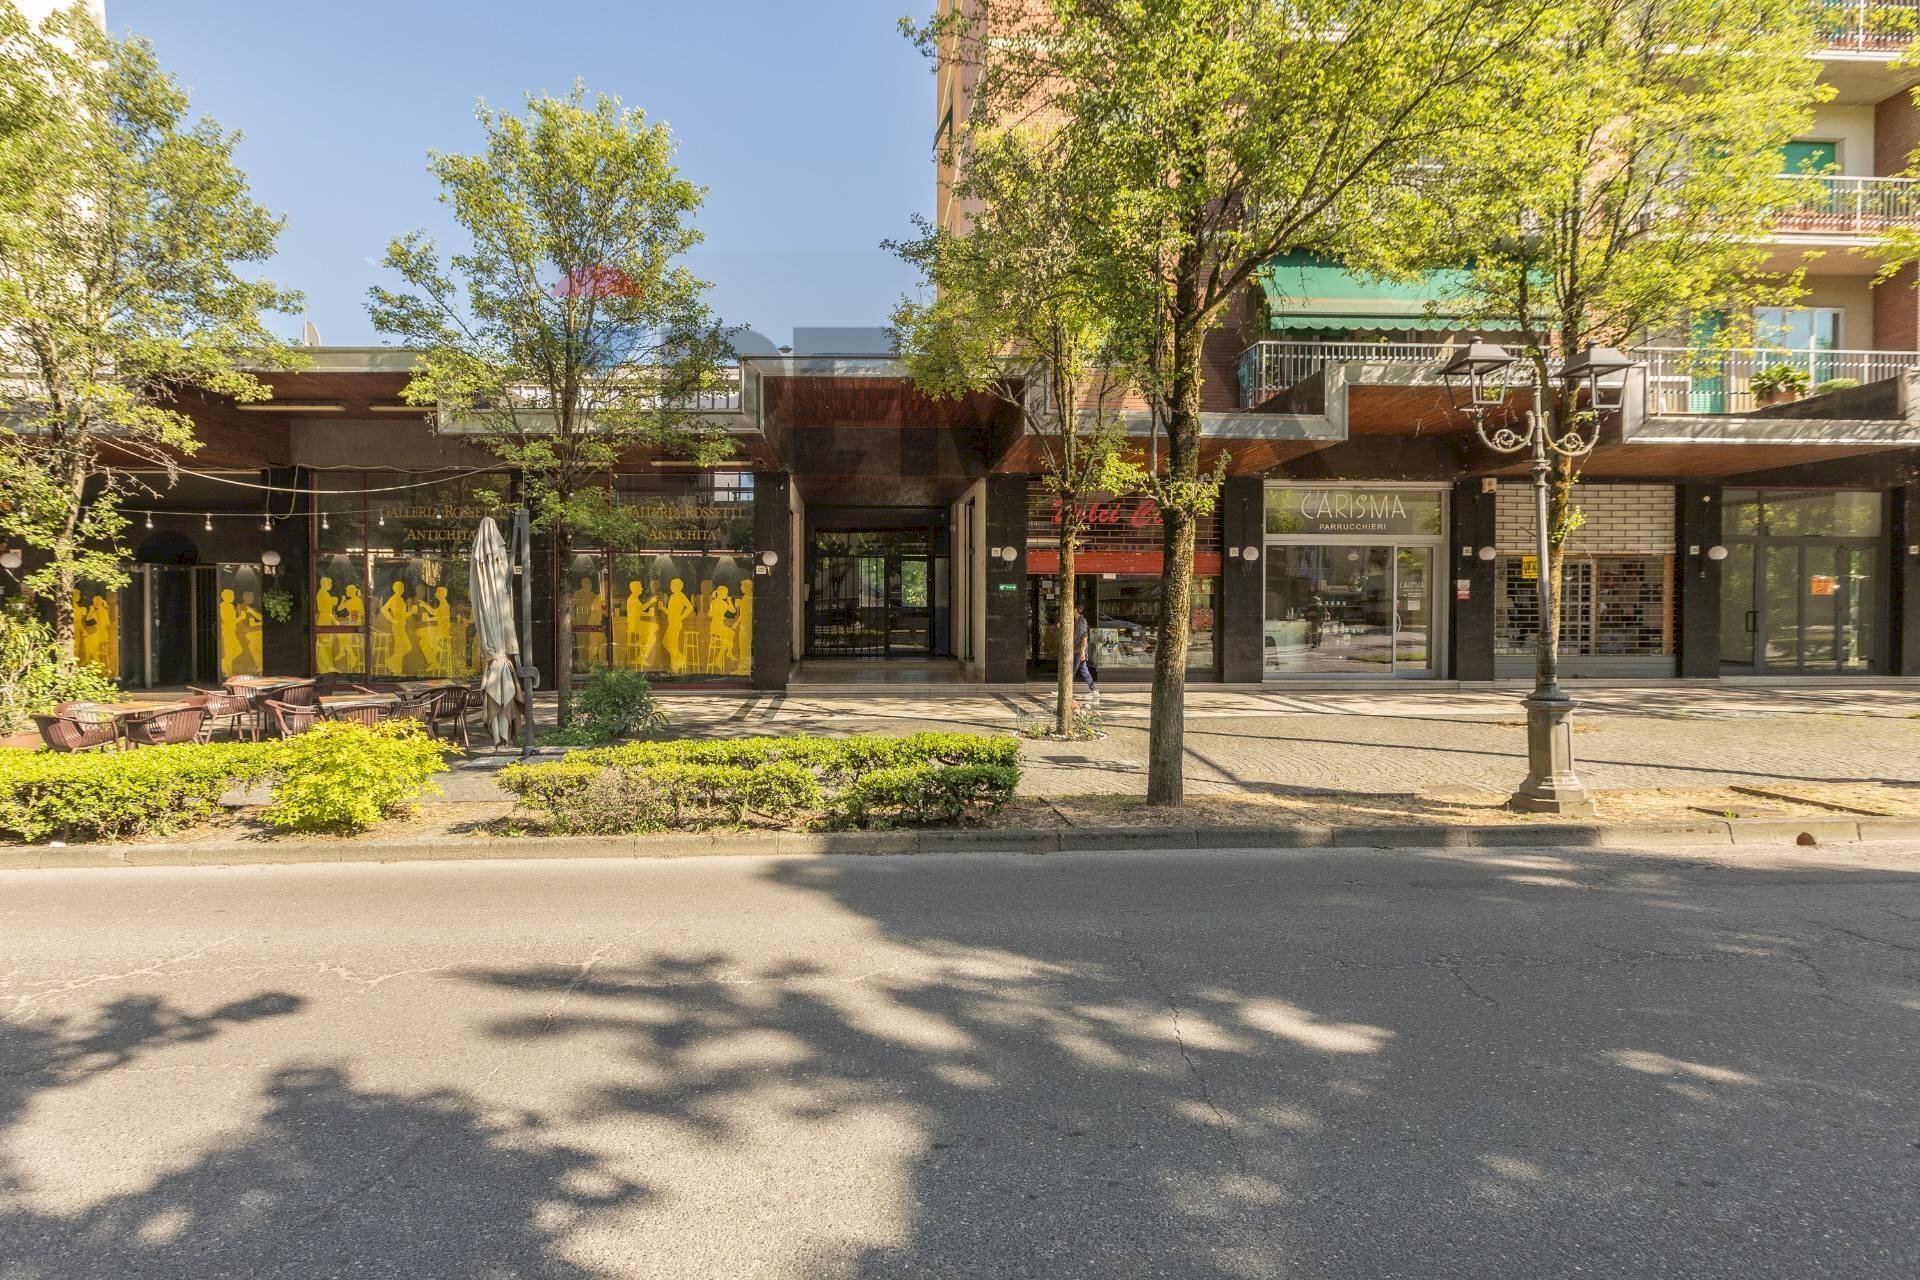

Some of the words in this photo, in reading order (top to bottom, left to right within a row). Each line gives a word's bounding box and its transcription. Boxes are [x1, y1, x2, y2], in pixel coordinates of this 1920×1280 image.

[686, 505, 743, 519] ROSSETTI
[1301, 494, 1406, 519] CARISMA
[1319, 523, 1387, 531] PARRUCCHIERI
